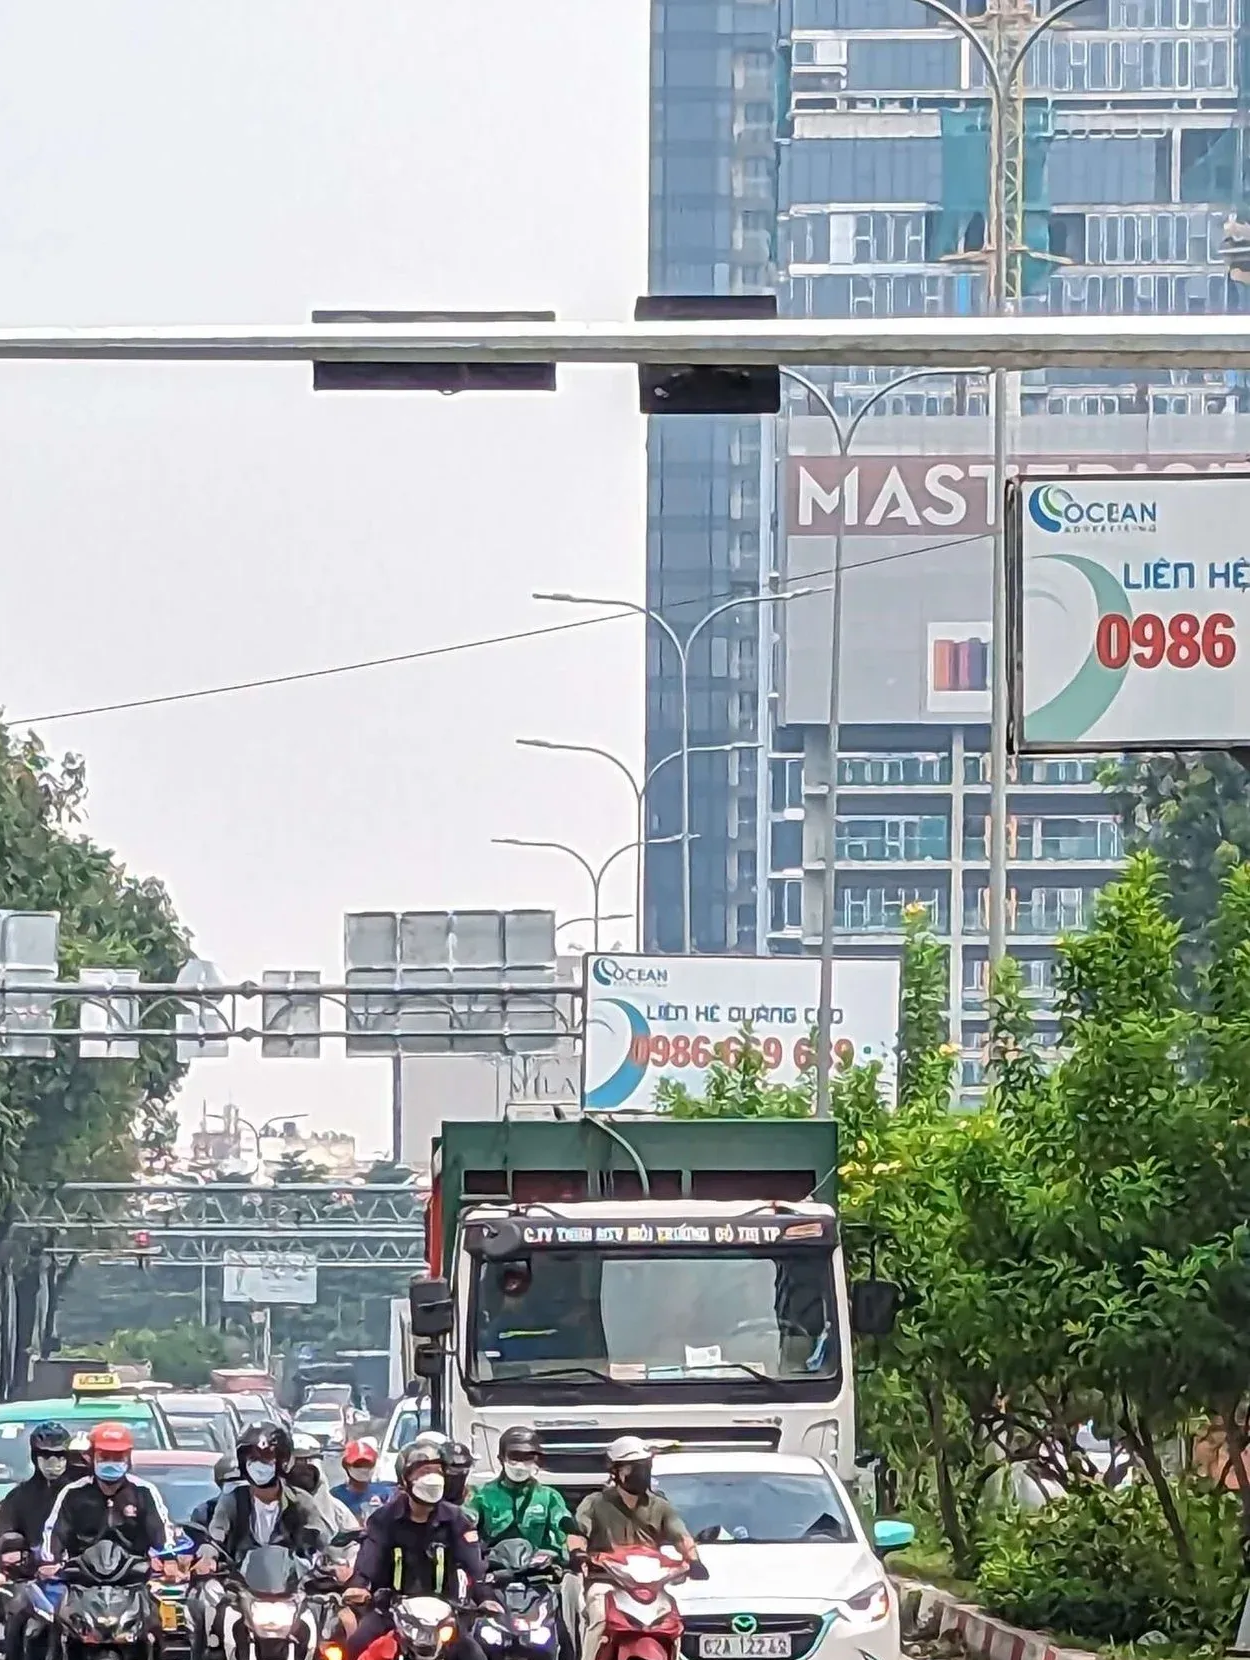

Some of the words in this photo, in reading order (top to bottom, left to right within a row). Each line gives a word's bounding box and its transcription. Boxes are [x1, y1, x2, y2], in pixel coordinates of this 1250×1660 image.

[1064, 502, 1157, 524] OCEAN
[1124, 557, 1195, 590] LIÊN
[1096, 612, 1237, 669] 0986
[613, 968, 668, 981] OCEAN
[631, 1035, 712, 1068] 0986
